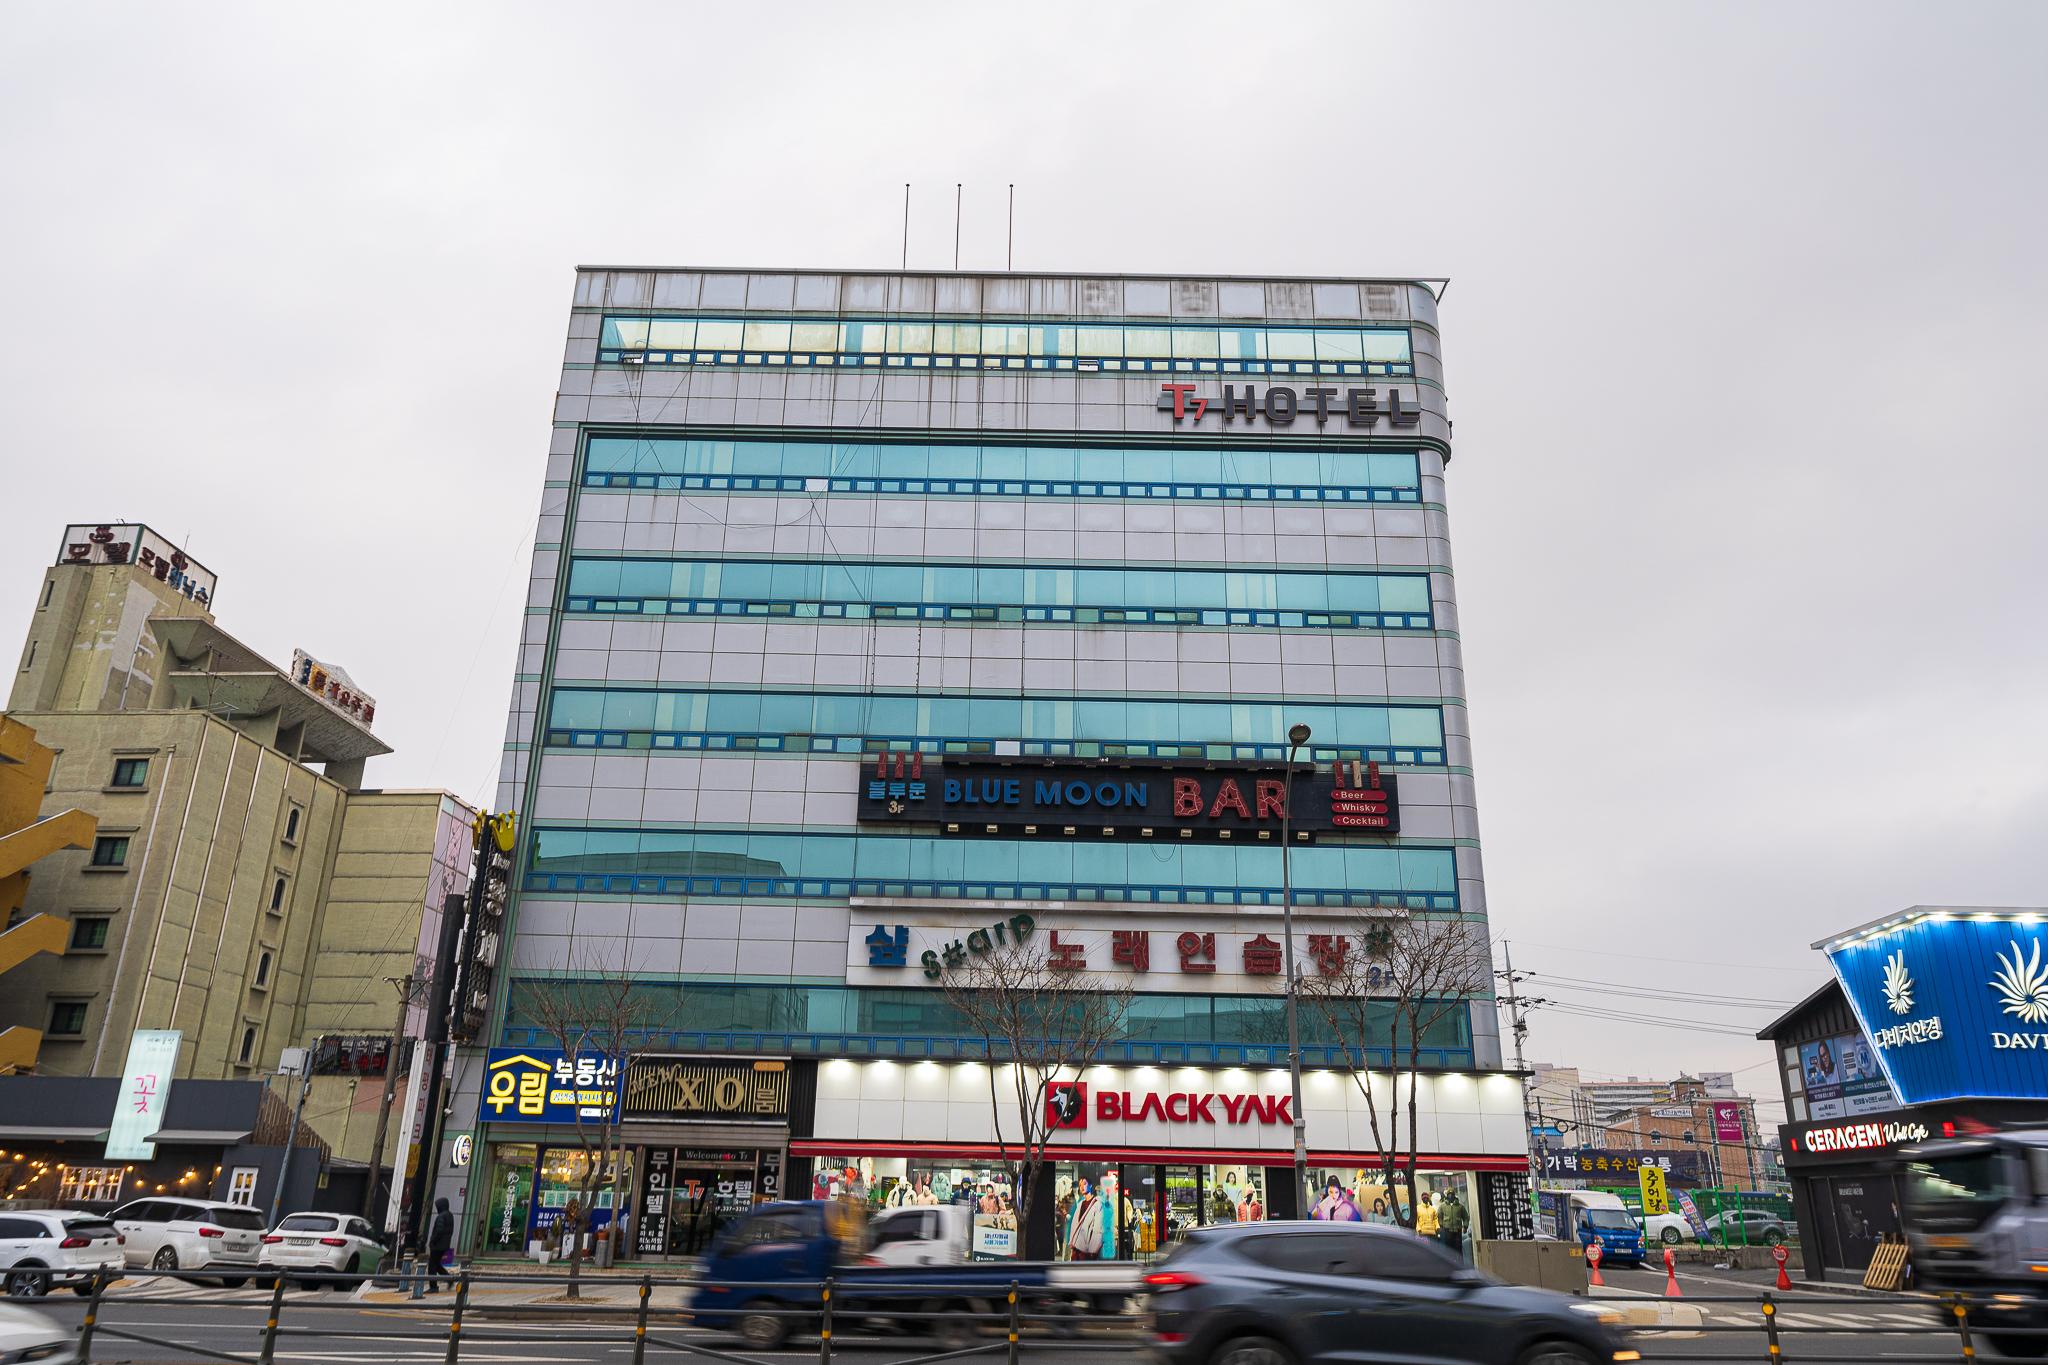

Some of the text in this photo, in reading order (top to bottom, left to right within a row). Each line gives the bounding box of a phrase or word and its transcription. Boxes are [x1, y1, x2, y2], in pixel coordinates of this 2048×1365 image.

[1162, 384, 1420, 423] T7 HOTEL
[62, 541, 131, 564] 모텔
[869, 782, 926, 799] 블루문
[944, 777, 1292, 819] BLUE MOON BAR
[1341, 791, 1364, 799] Beer
[889, 801, 904, 813] 3F
[1342, 804, 1376, 812] Whisky
[1342, 817, 1384, 825] Cocktail
[865, 925, 909, 967] 샵
[1873, 1016, 1944, 1050] 다비치안경
[133, 1075, 156, 1113] 꽃
[487, 1058, 617, 1114] 우림 부동산
[630, 1063, 681, 1094] NEW
[673, 1077, 744, 1110] XO
[1805, 1123, 1883, 1152] CERAGEM
[646, 1151, 669, 1214] 무인텔
[714, 1181, 752, 1199] 호텔
[1646, 1170, 1662, 1211] 추어탕
